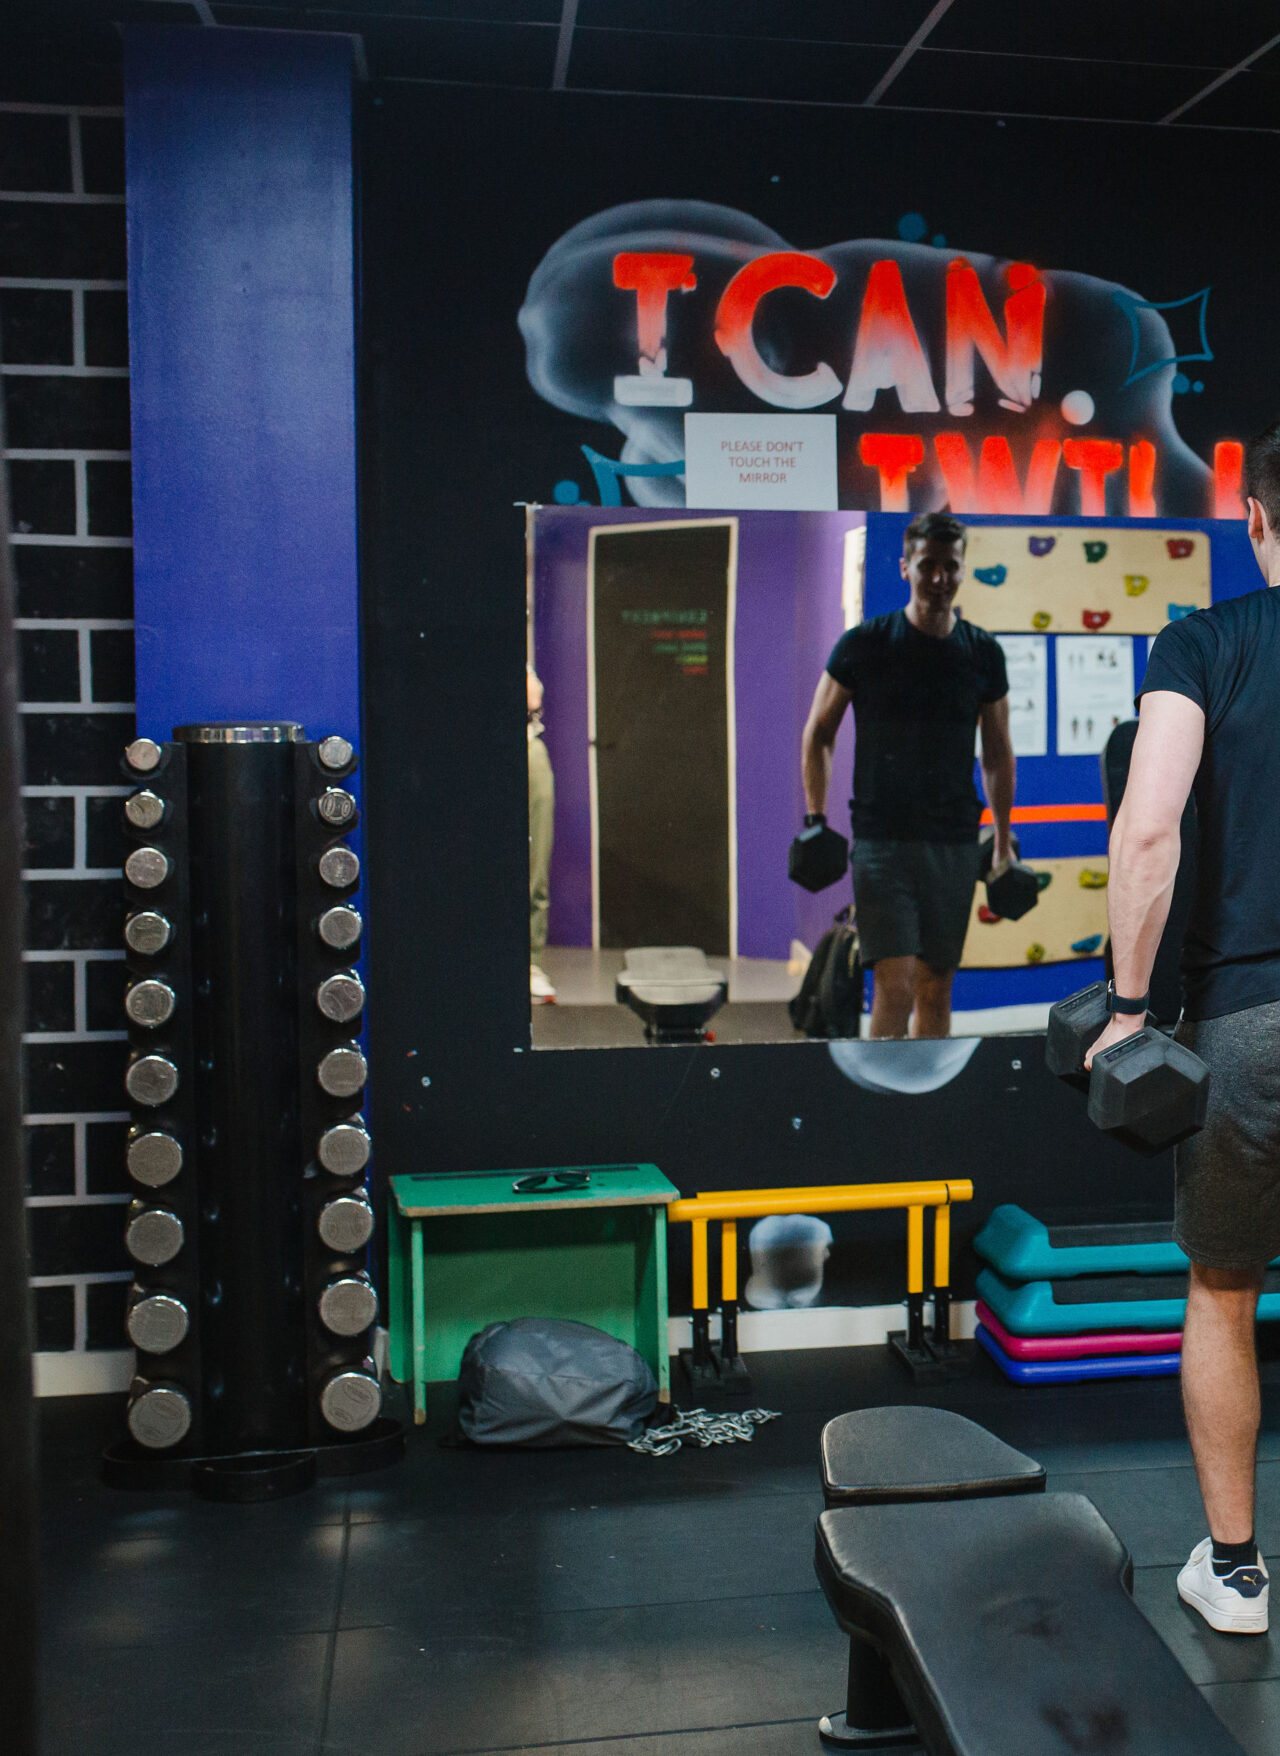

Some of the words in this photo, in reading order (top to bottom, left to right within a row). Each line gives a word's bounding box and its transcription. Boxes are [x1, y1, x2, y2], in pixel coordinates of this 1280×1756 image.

[613, 252, 697, 407] I
[720, 440, 763, 453] PLEASE
[766, 441, 804, 453] DON'T
[728, 456, 771, 468] TOUCH
[773, 457, 797, 468] THE
[739, 473, 787, 484] MIRROR
